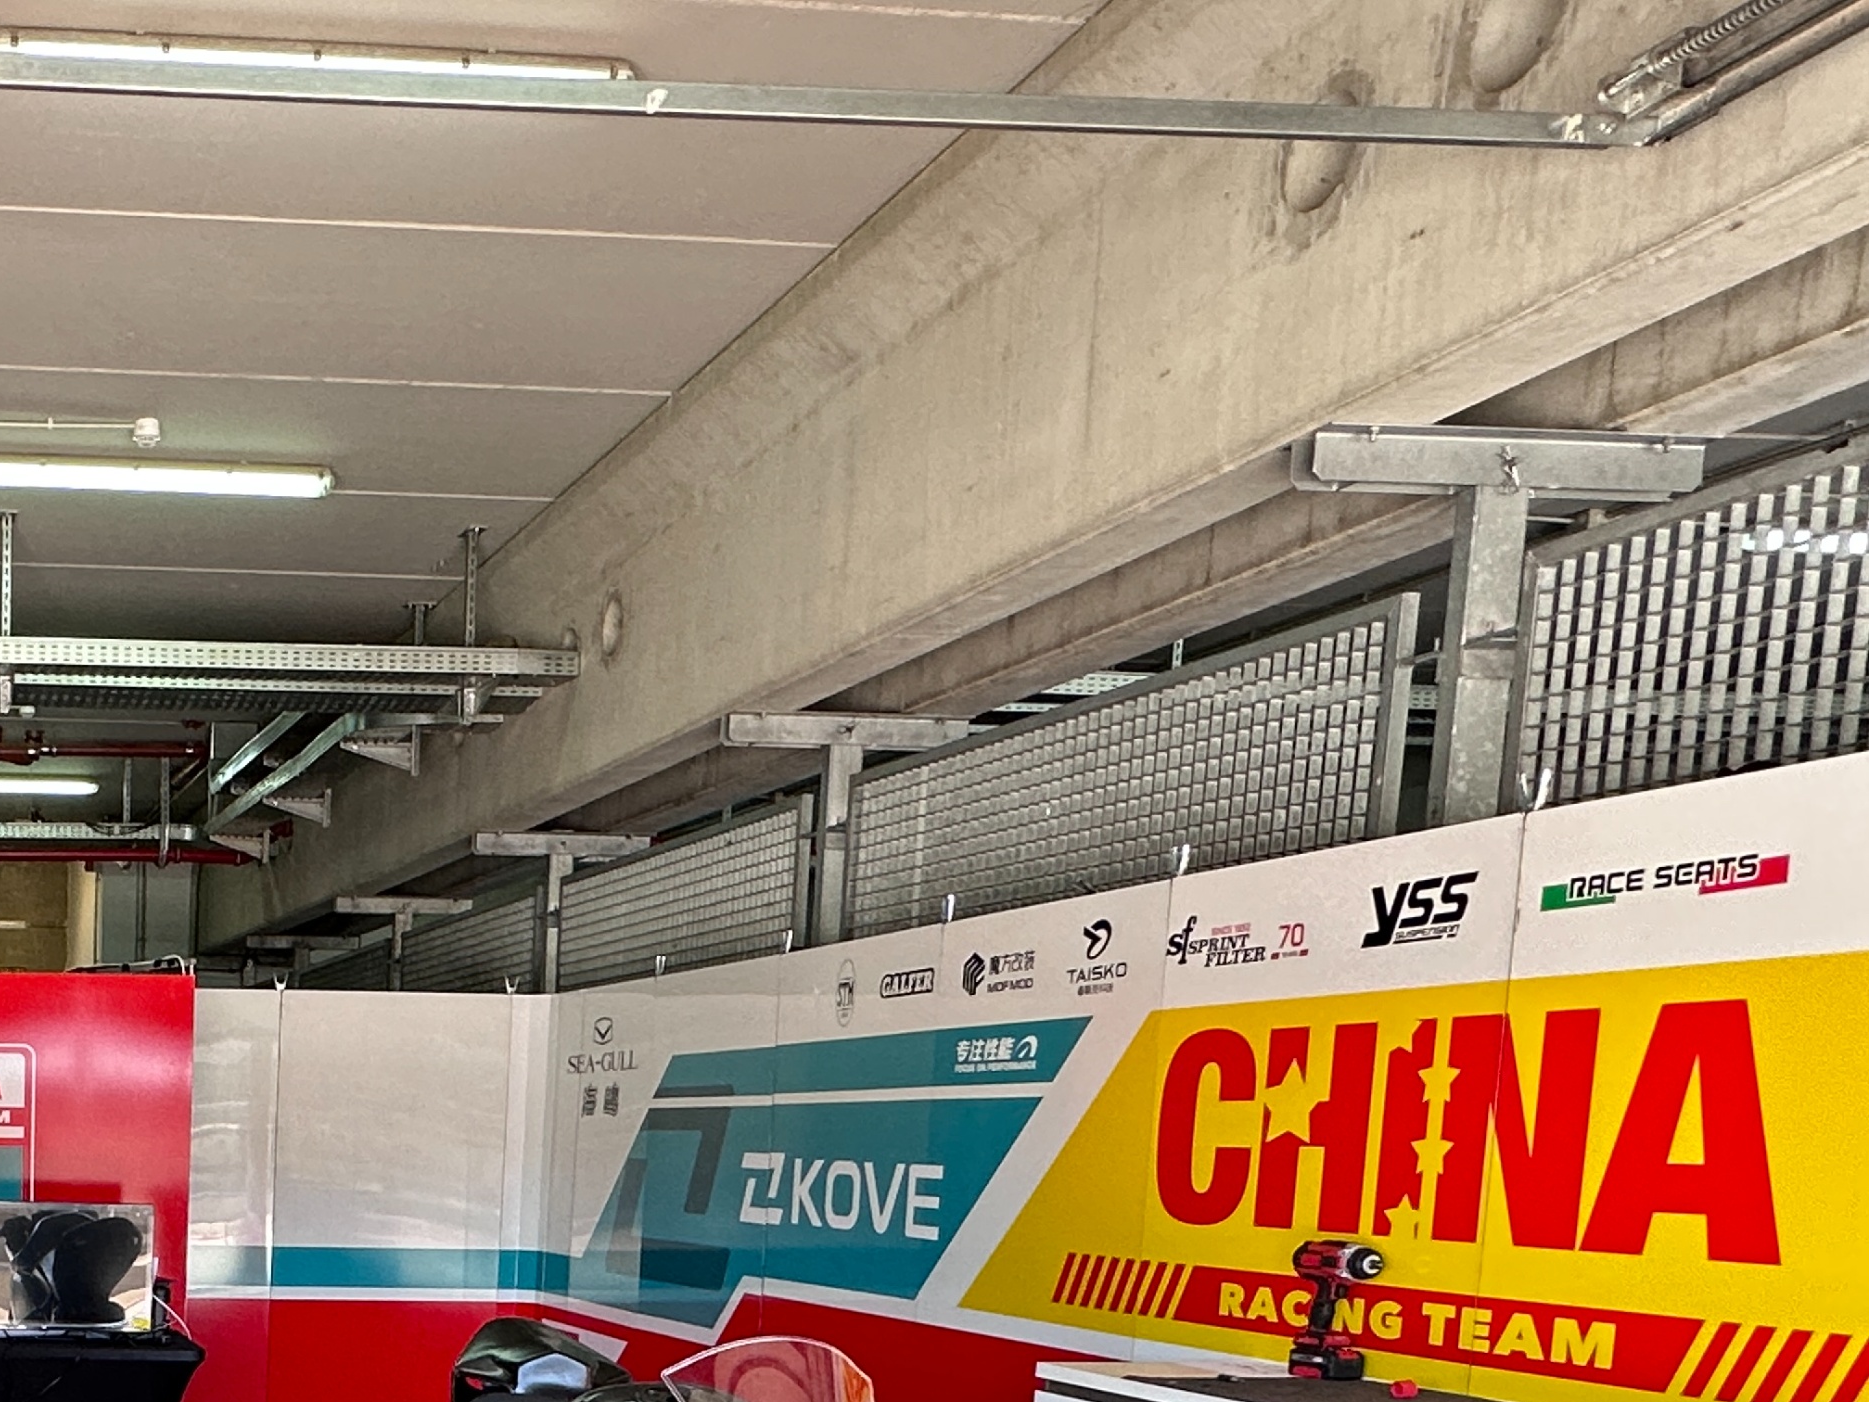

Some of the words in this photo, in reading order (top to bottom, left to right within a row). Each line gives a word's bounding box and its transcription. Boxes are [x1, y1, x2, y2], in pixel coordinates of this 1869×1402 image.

[1569, 868, 1646, 899] RACE
[1653, 853, 1760, 889] SEATS
[1188, 933, 1251, 955] SPRINT
[1278, 922, 1305, 949] 70
[1204, 946, 1267, 968] FILTER
[1066, 962, 1127, 984] TAISKO
[956, 1037, 1015, 1062] 专注性能
[1156, 998, 1782, 1267] CHINA
[791, 1159, 944, 1241] KOVE
[1218, 1281, 1403, 1341] RACNG
[1423, 1303, 1616, 1371] TEAM
